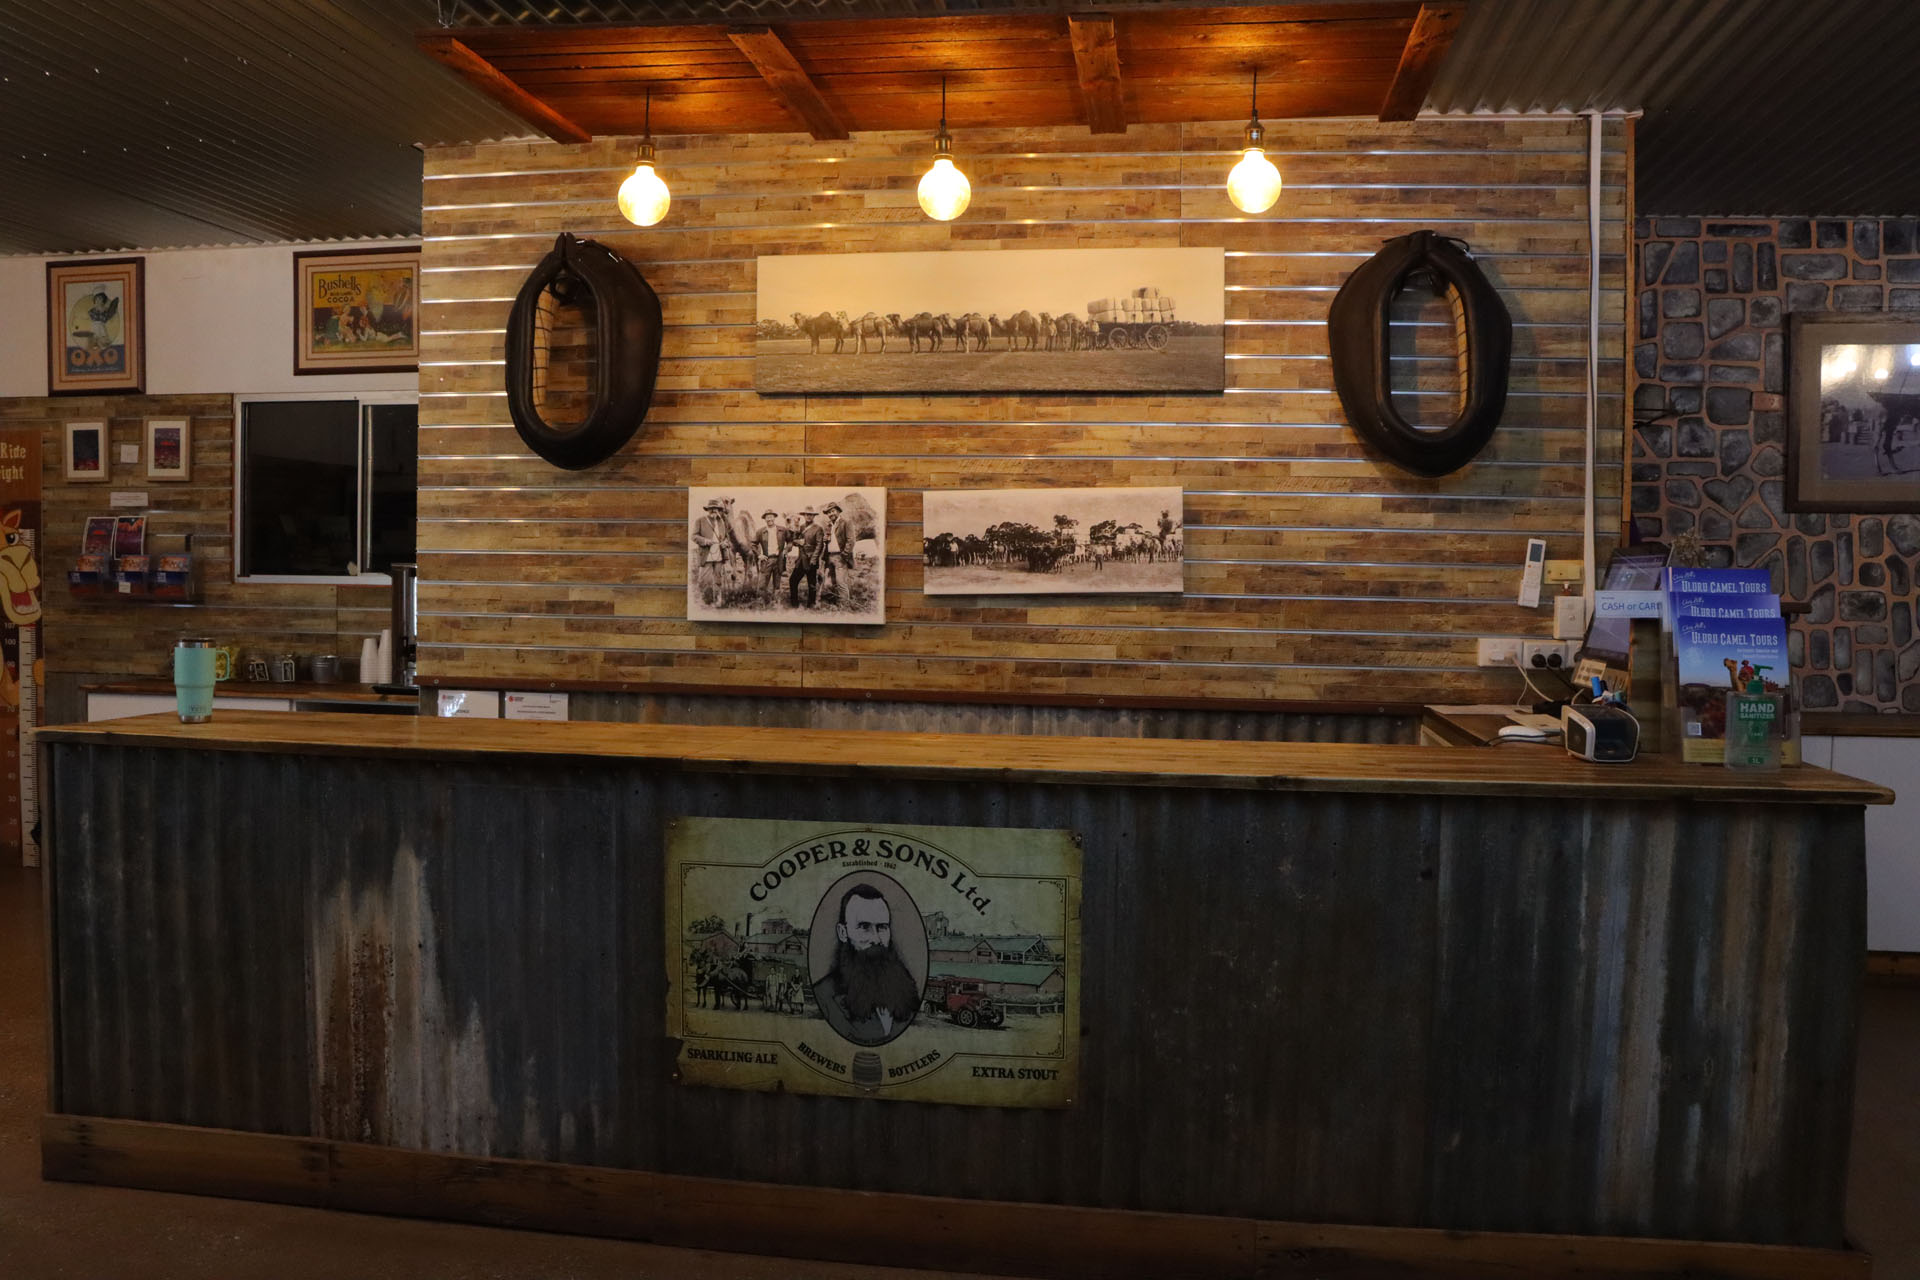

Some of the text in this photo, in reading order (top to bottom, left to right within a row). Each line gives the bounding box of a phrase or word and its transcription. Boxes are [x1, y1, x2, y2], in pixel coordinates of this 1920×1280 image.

[318, 274, 362, 299] Bushells
[71, 347, 119, 366] OXO
[1681, 580, 1767, 593] ULURU CAMEL TOURS
[1601, 602, 1625, 610] CASH
[1747, 608, 1776, 618] TOURS
[1691, 631, 1778, 646] ULURU CAMEL TOURS
[1740, 703, 1775, 713] HAND
[842, 860, 878, 868] Established
[750, 838, 991, 915] COOPER & SONS Ltd.
[687, 1047, 778, 1065] SPARKLING ALE
[797, 1042, 847, 1074] BREWERS
[888, 1049, 941, 1078] BOTTLERS
[972, 1066, 1060, 1081] EXTRA STOUT
